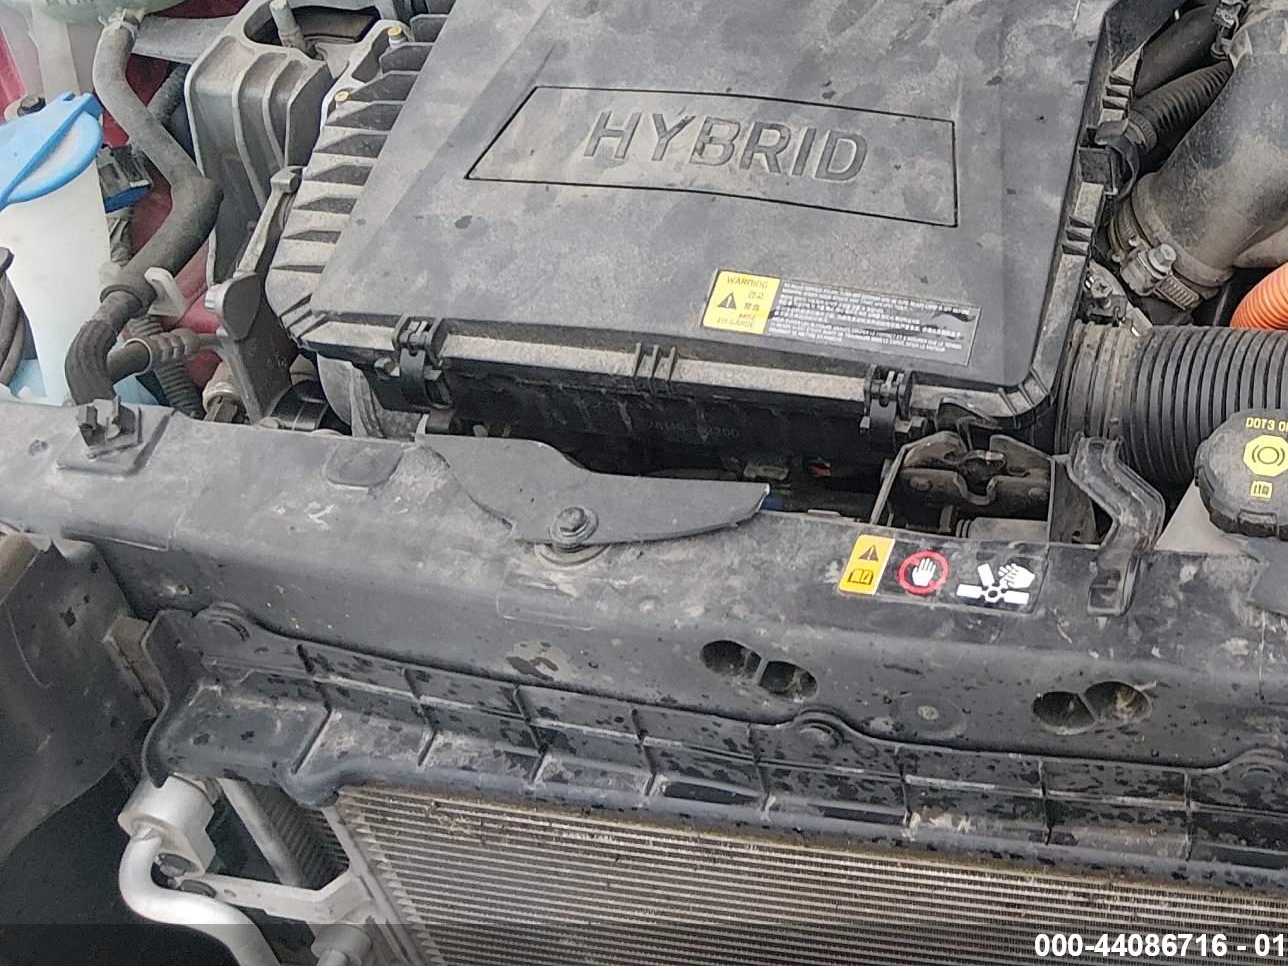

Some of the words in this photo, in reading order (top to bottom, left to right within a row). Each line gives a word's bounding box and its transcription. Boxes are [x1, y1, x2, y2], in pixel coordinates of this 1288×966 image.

[583, 110, 868, 183] HYBRID
[726, 275, 769, 289] WARNING
[1245, 417, 1275, 431] DOT3
